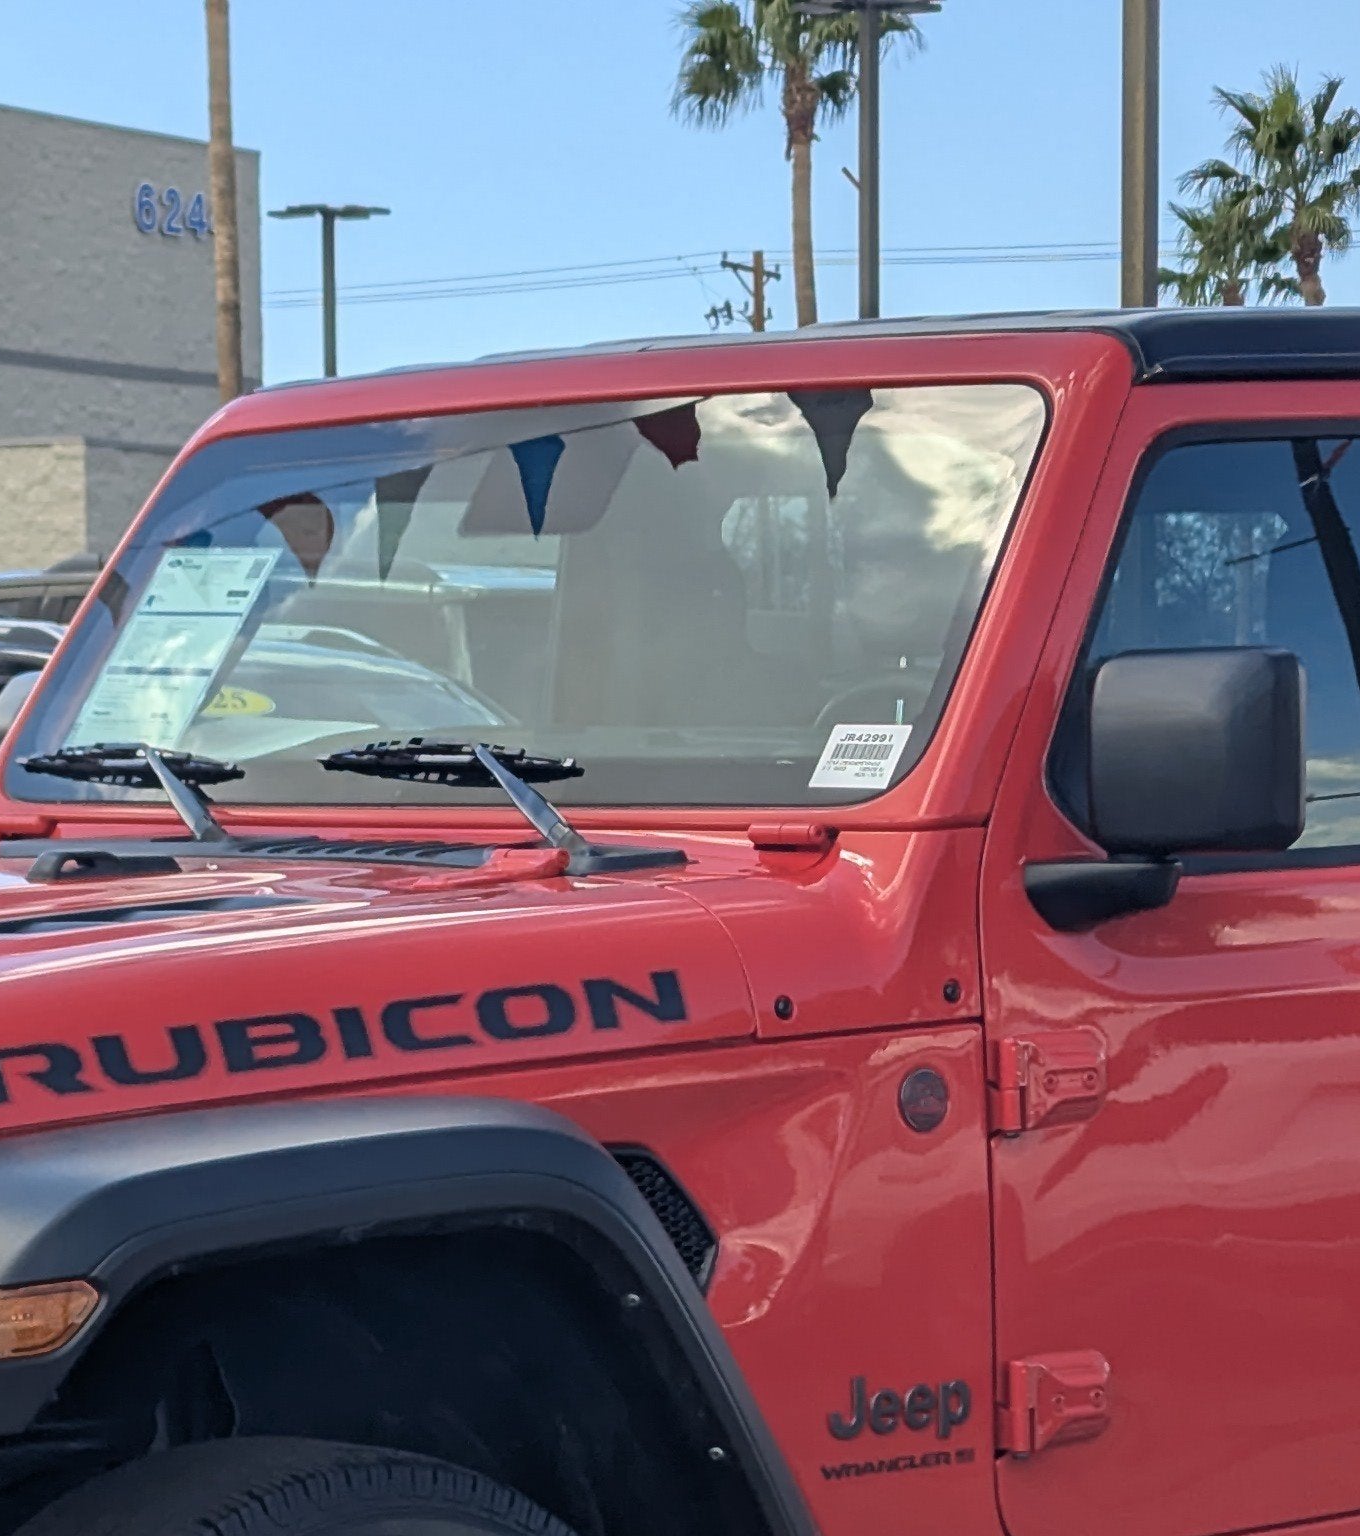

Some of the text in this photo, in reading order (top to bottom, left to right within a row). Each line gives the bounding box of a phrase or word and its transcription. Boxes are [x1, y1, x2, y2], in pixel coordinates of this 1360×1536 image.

[136, 182, 215, 238] 624
[840, 733, 893, 742] JR42991
[828, 1375, 971, 1440] Jeep
[821, 1451, 952, 1480] WRANGLER
